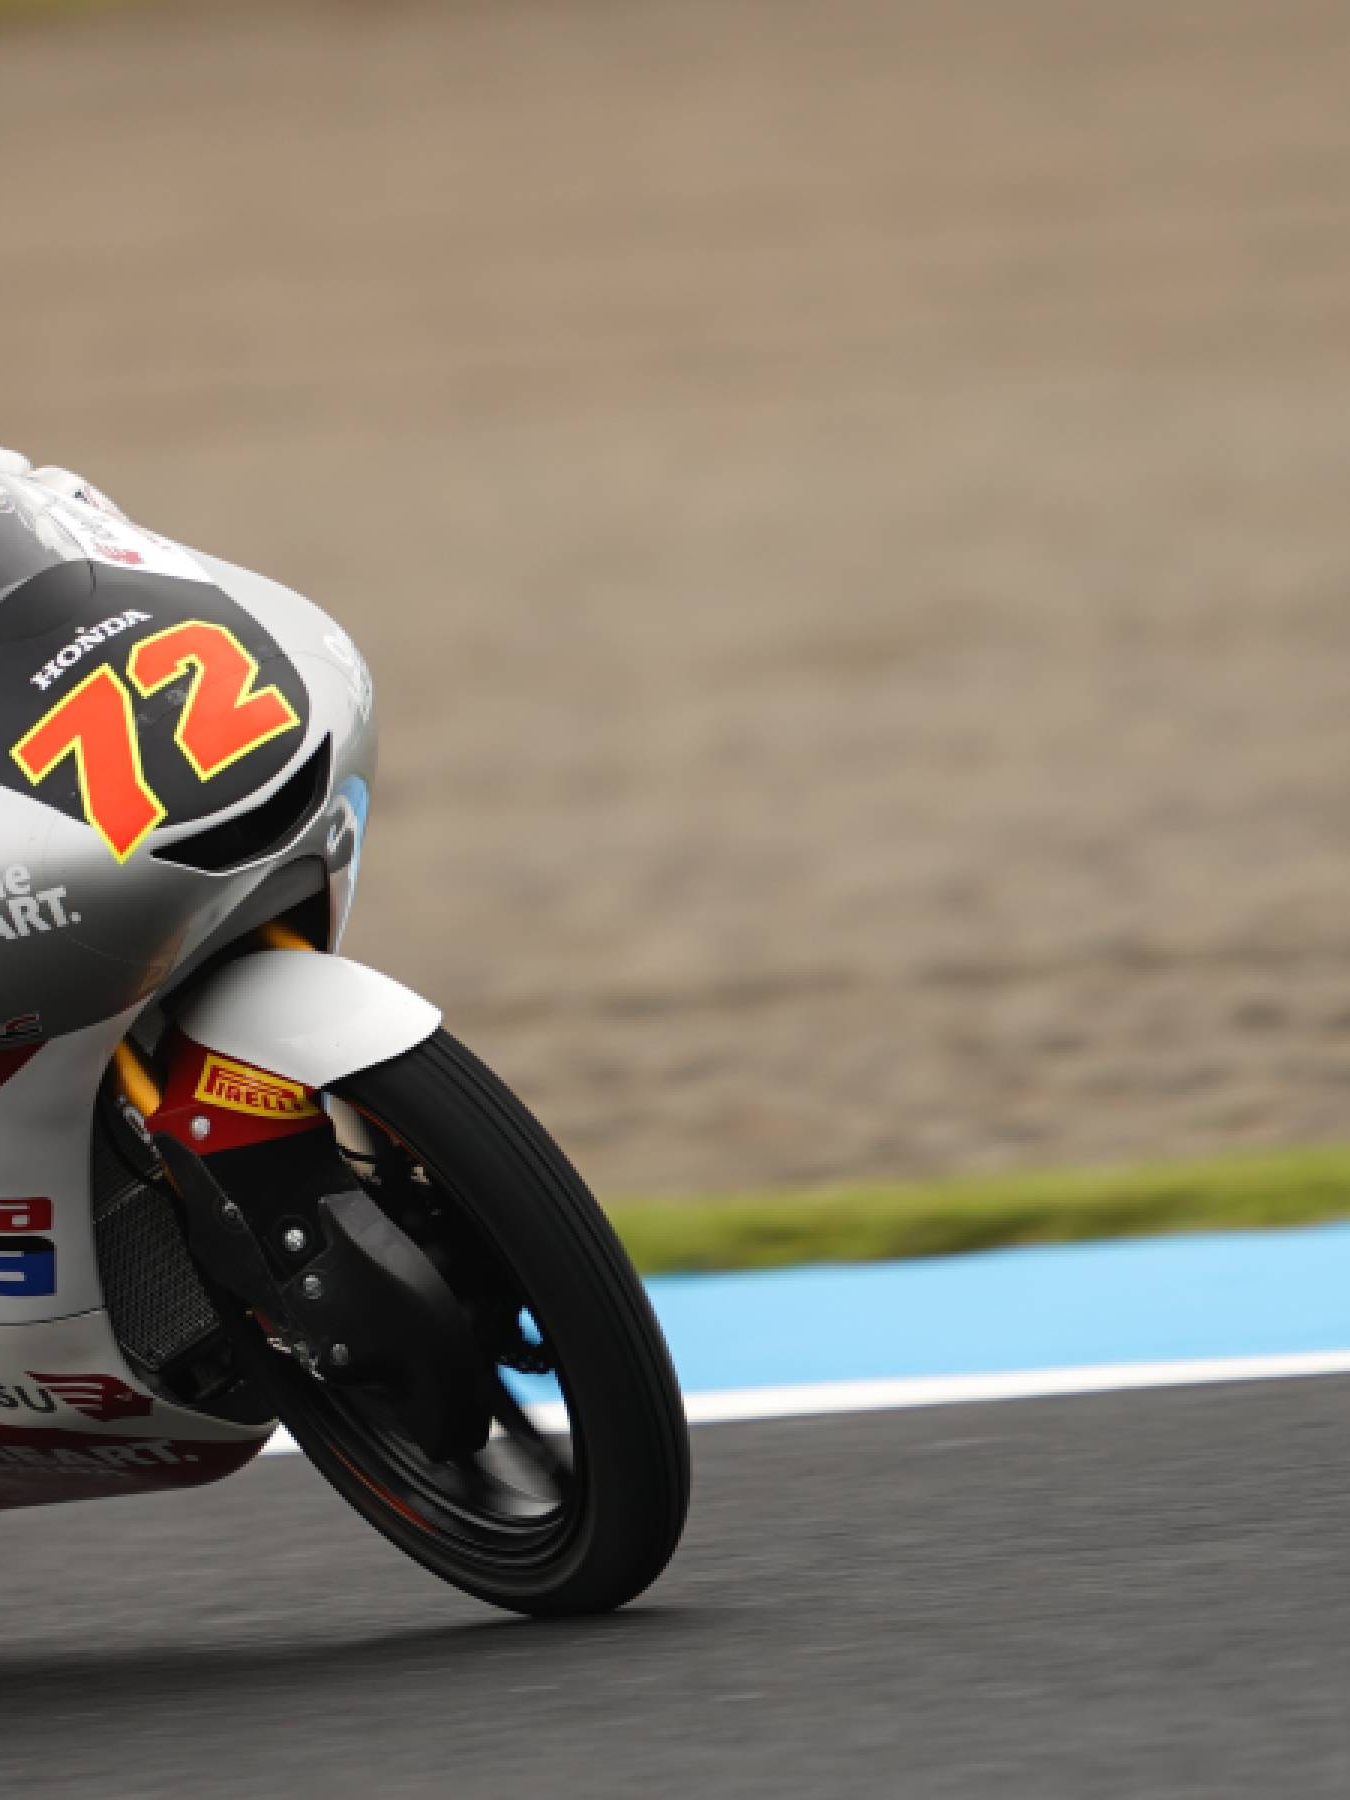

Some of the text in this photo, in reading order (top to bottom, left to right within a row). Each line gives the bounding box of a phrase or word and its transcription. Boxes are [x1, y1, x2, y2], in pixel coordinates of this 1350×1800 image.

[29, 609, 152, 691] HONDA
[9, 618, 301, 864] 72
[204, 1065, 304, 1112] PIRELLI
